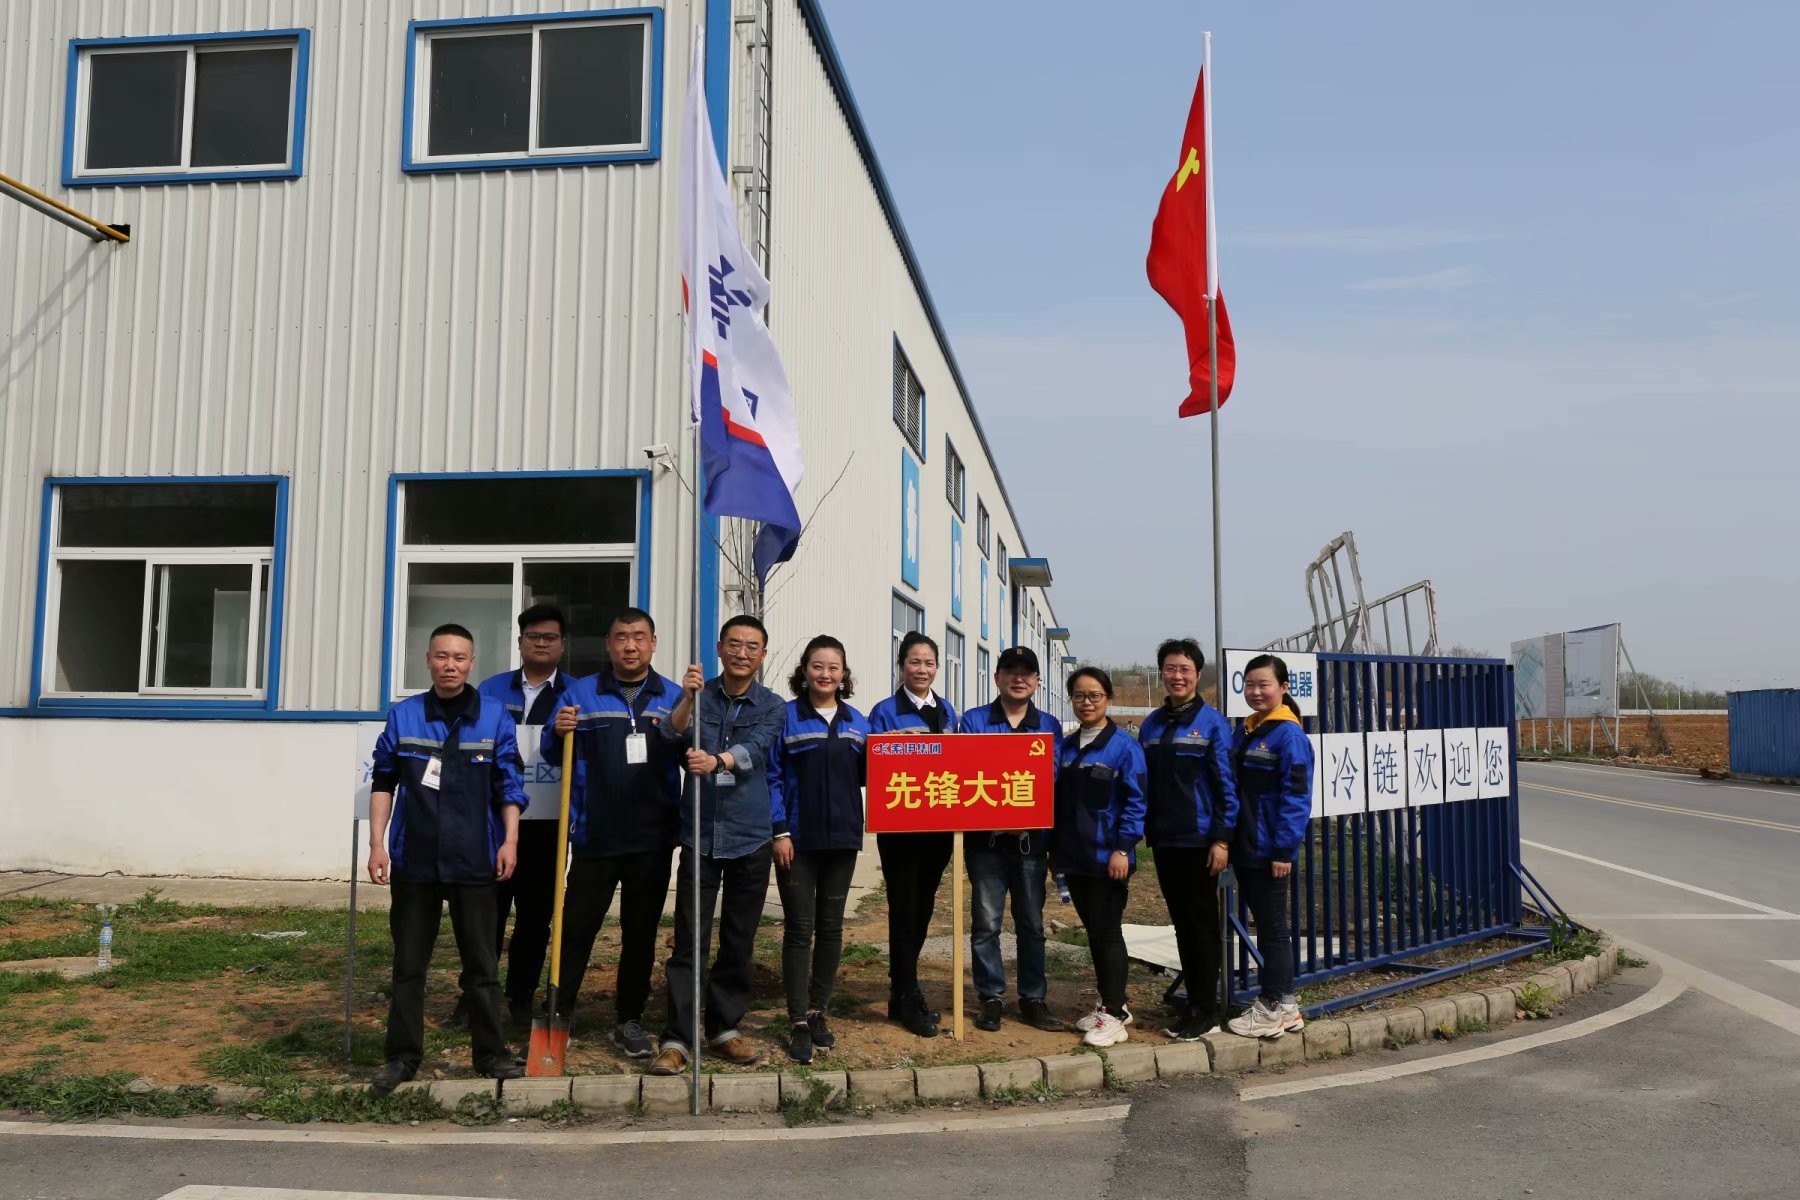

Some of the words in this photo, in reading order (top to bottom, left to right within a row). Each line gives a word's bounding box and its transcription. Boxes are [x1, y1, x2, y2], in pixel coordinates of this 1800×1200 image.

[885, 770, 1036, 809] 先锋大道
[1331, 739, 1503, 800] 冷链欢迎您
